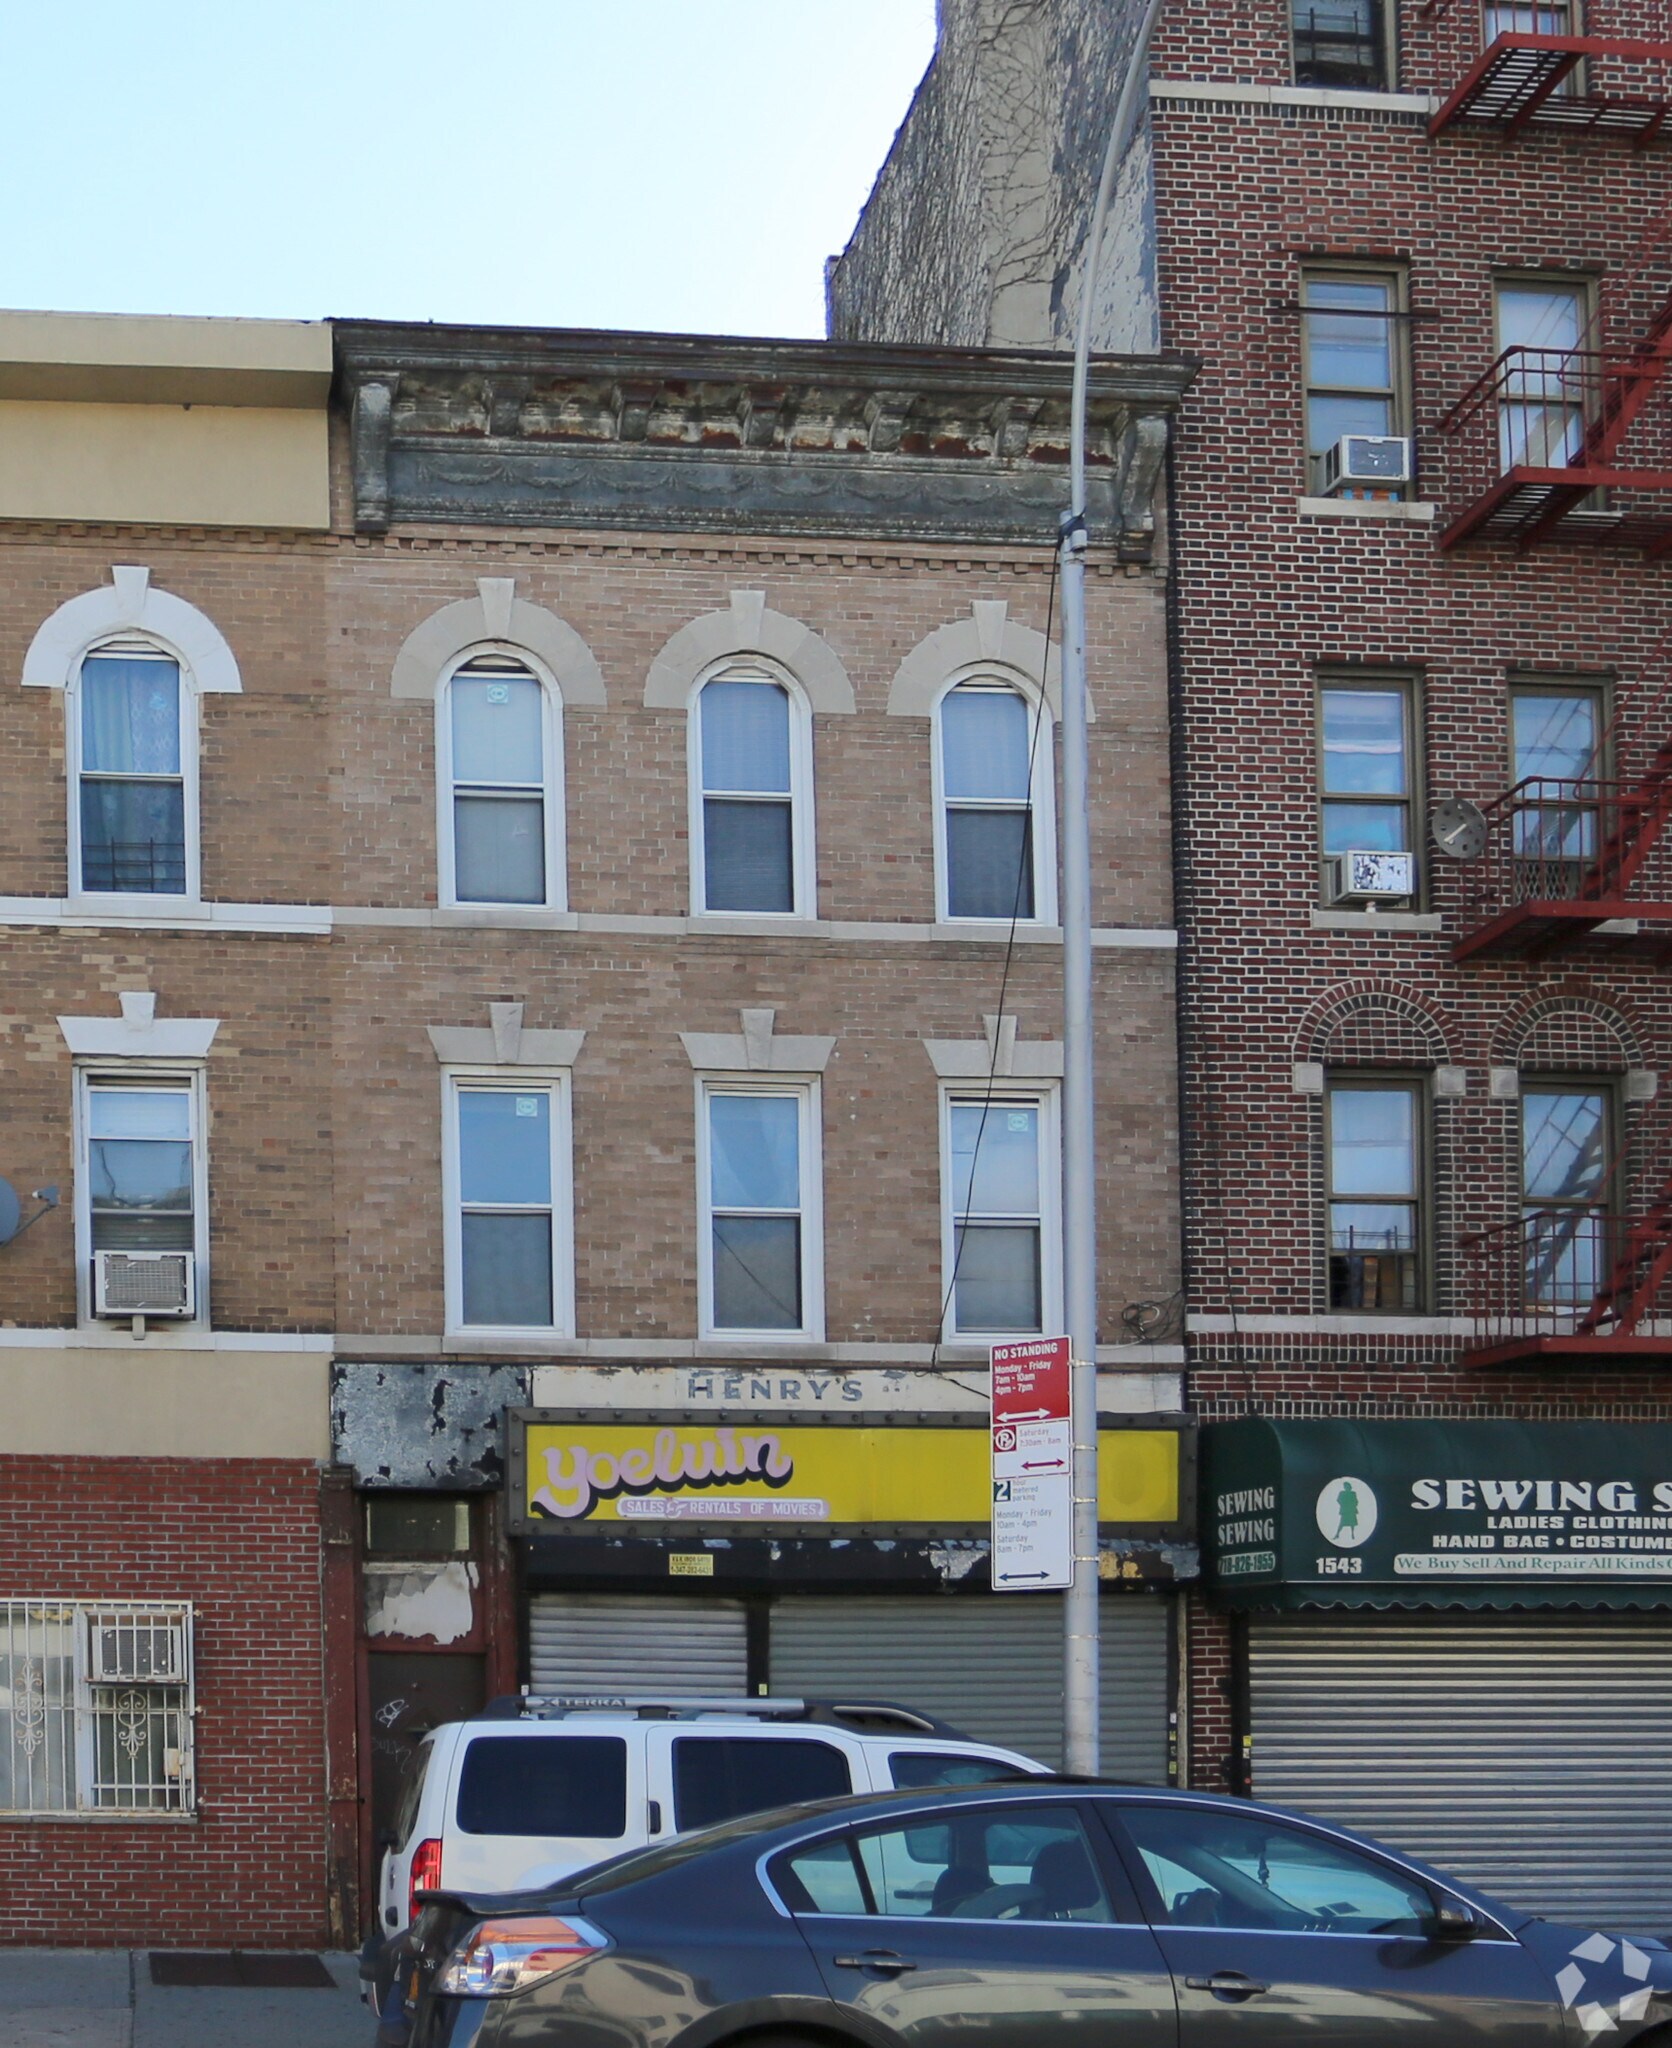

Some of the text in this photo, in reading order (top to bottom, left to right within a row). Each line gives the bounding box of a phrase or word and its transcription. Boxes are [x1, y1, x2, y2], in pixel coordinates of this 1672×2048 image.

[994, 1342, 1058, 1360] NO STANDING
[995, 1364, 1022, 1374] Monday
[1029, 1360, 1052, 1371] Friday
[995, 1376, 1011, 1385] 7am
[1017, 1373, 1036, 1382] 10am
[688, 1378, 863, 1402] HENRY'S
[995, 1386, 1012, 1396] 4pm
[1018, 1383, 1033, 1393] 7pm
[1019, 1429, 1049, 1437] Saturday
[996, 1481, 1009, 1501] 2
[1411, 1479, 1637, 1512] SEWING
[626, 1501, 665, 1514] SALES
[690, 1503, 741, 1515] RENTALS
[750, 1503, 765, 1515] OF
[772, 1504, 817, 1516] MOVIES
[1217, 1486, 1275, 1517] SEWING
[996, 1511, 1023, 1519] Monday
[1030, 1509, 1052, 1517] Friday
[1487, 1516, 1564, 1529] LADIES
[997, 1535, 1028, 1544] Saturday
[1217, 1518, 1275, 1547] SEWING
[1432, 1535, 1495, 1548] HAND
[1503, 1535, 1550, 1548] BAG
[1316, 1557, 1362, 1574] 1543
[1397, 1557, 1422, 1569] We
[1428, 1557, 1459, 1572] Buy
[1462, 1557, 1490, 1569] Sell
[1494, 1557, 1527, 1569] And
[1531, 1557, 1586, 1572] Repair
[1589, 1558, 1612, 1569] All
[1616, 1558, 1664, 1569] Kinds
